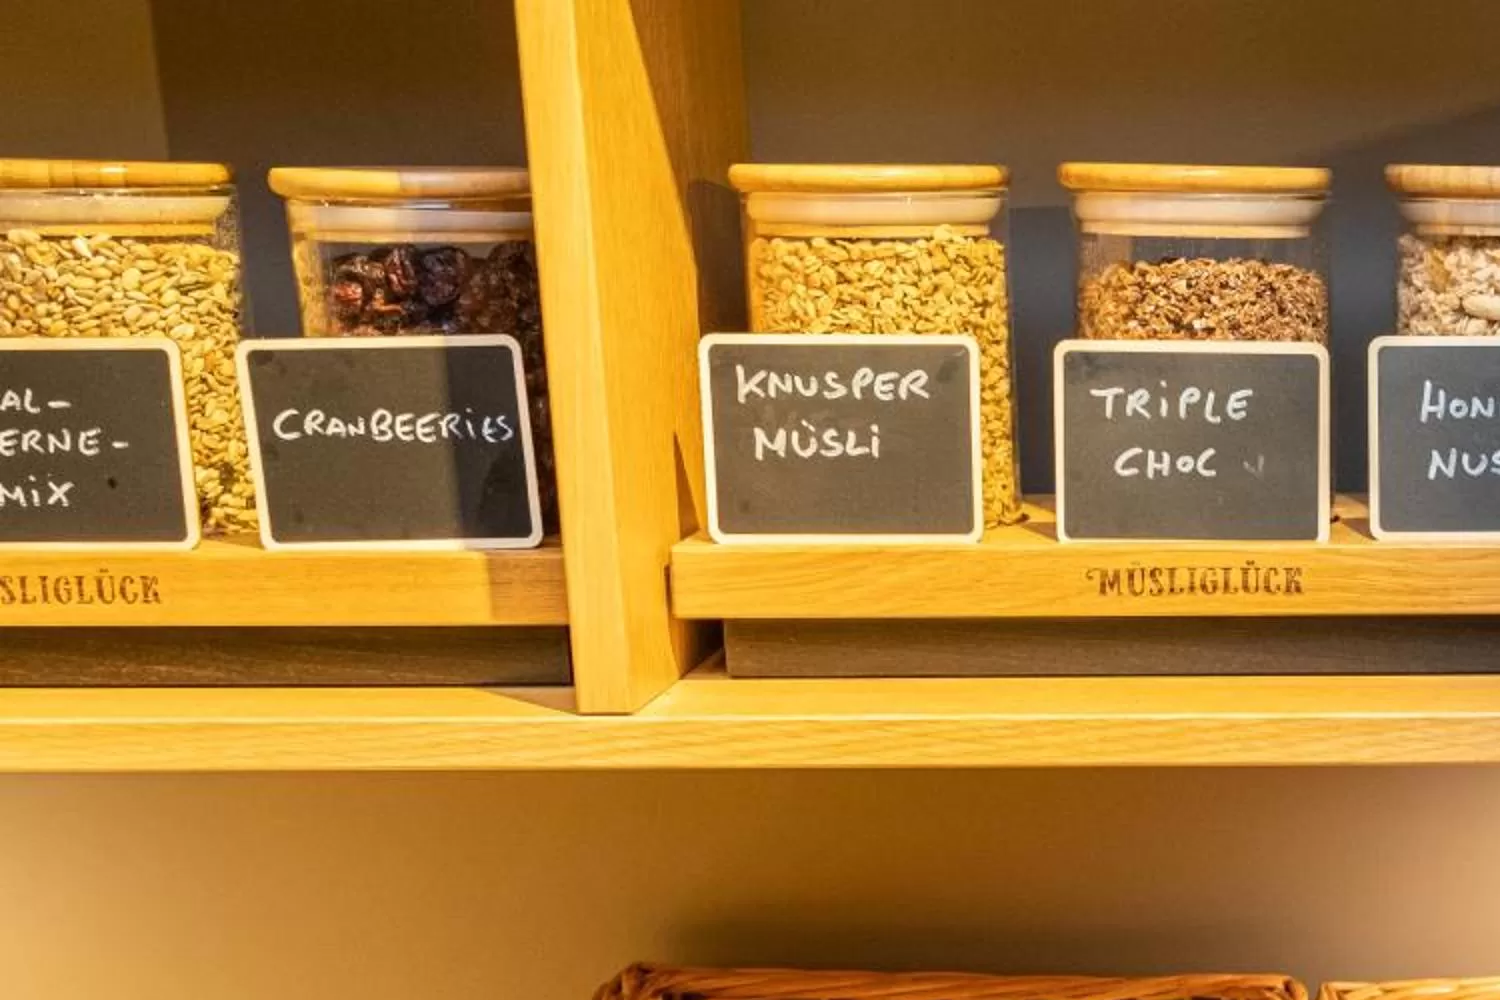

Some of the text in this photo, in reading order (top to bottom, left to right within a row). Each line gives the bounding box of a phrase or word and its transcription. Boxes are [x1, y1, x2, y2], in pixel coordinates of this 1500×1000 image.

[735, 364, 930, 404] KNUSPER
[1114, 447, 1217, 480] CHOC
[1085, 560, 1305, 597] MÜSLIGLÜCK
